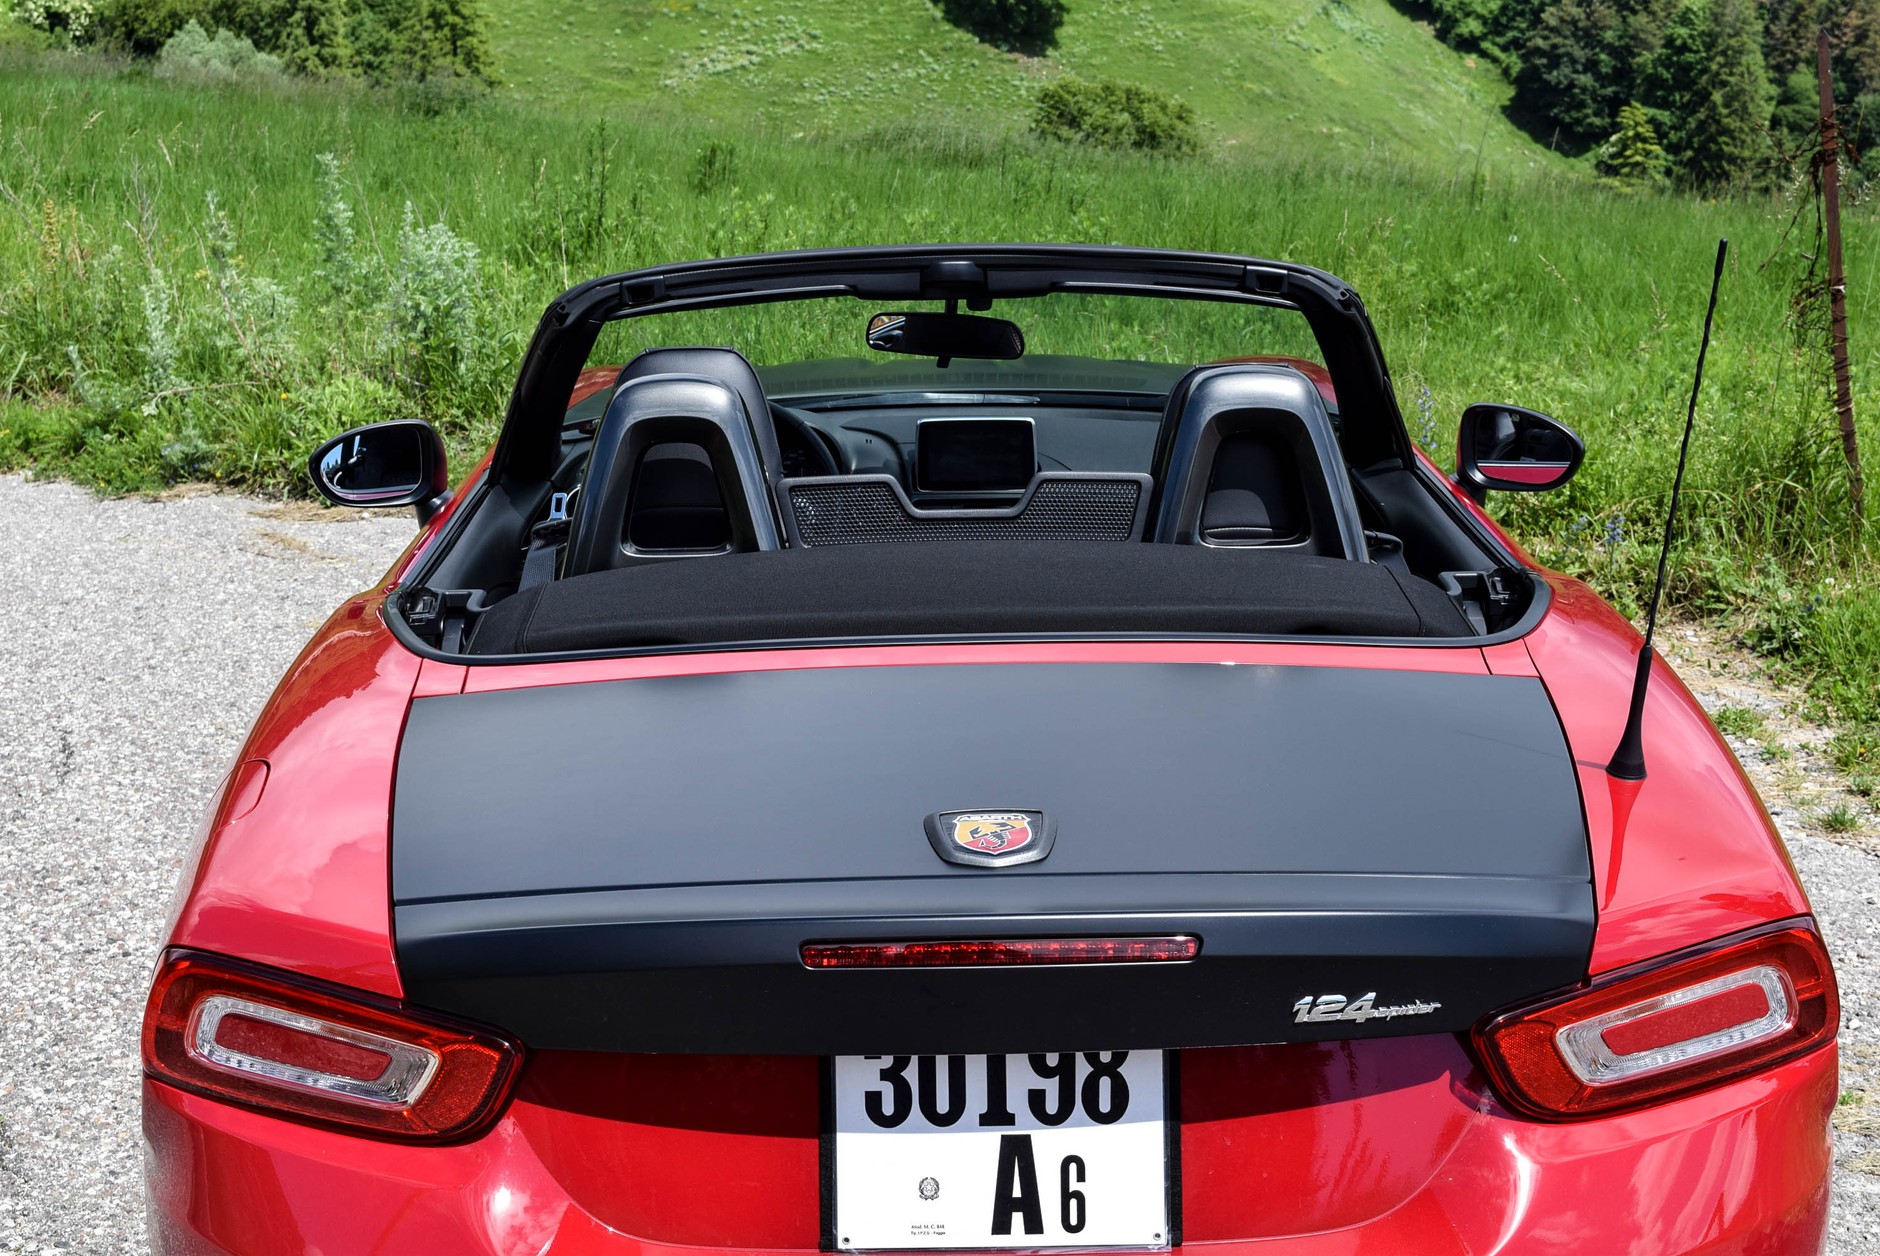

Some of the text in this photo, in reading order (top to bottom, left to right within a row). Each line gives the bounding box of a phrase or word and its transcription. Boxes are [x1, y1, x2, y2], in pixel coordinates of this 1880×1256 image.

[1292, 992, 1377, 1024] 124
[864, 1050, 1130, 1129] 30198
[991, 1134, 1086, 1235] A 6
